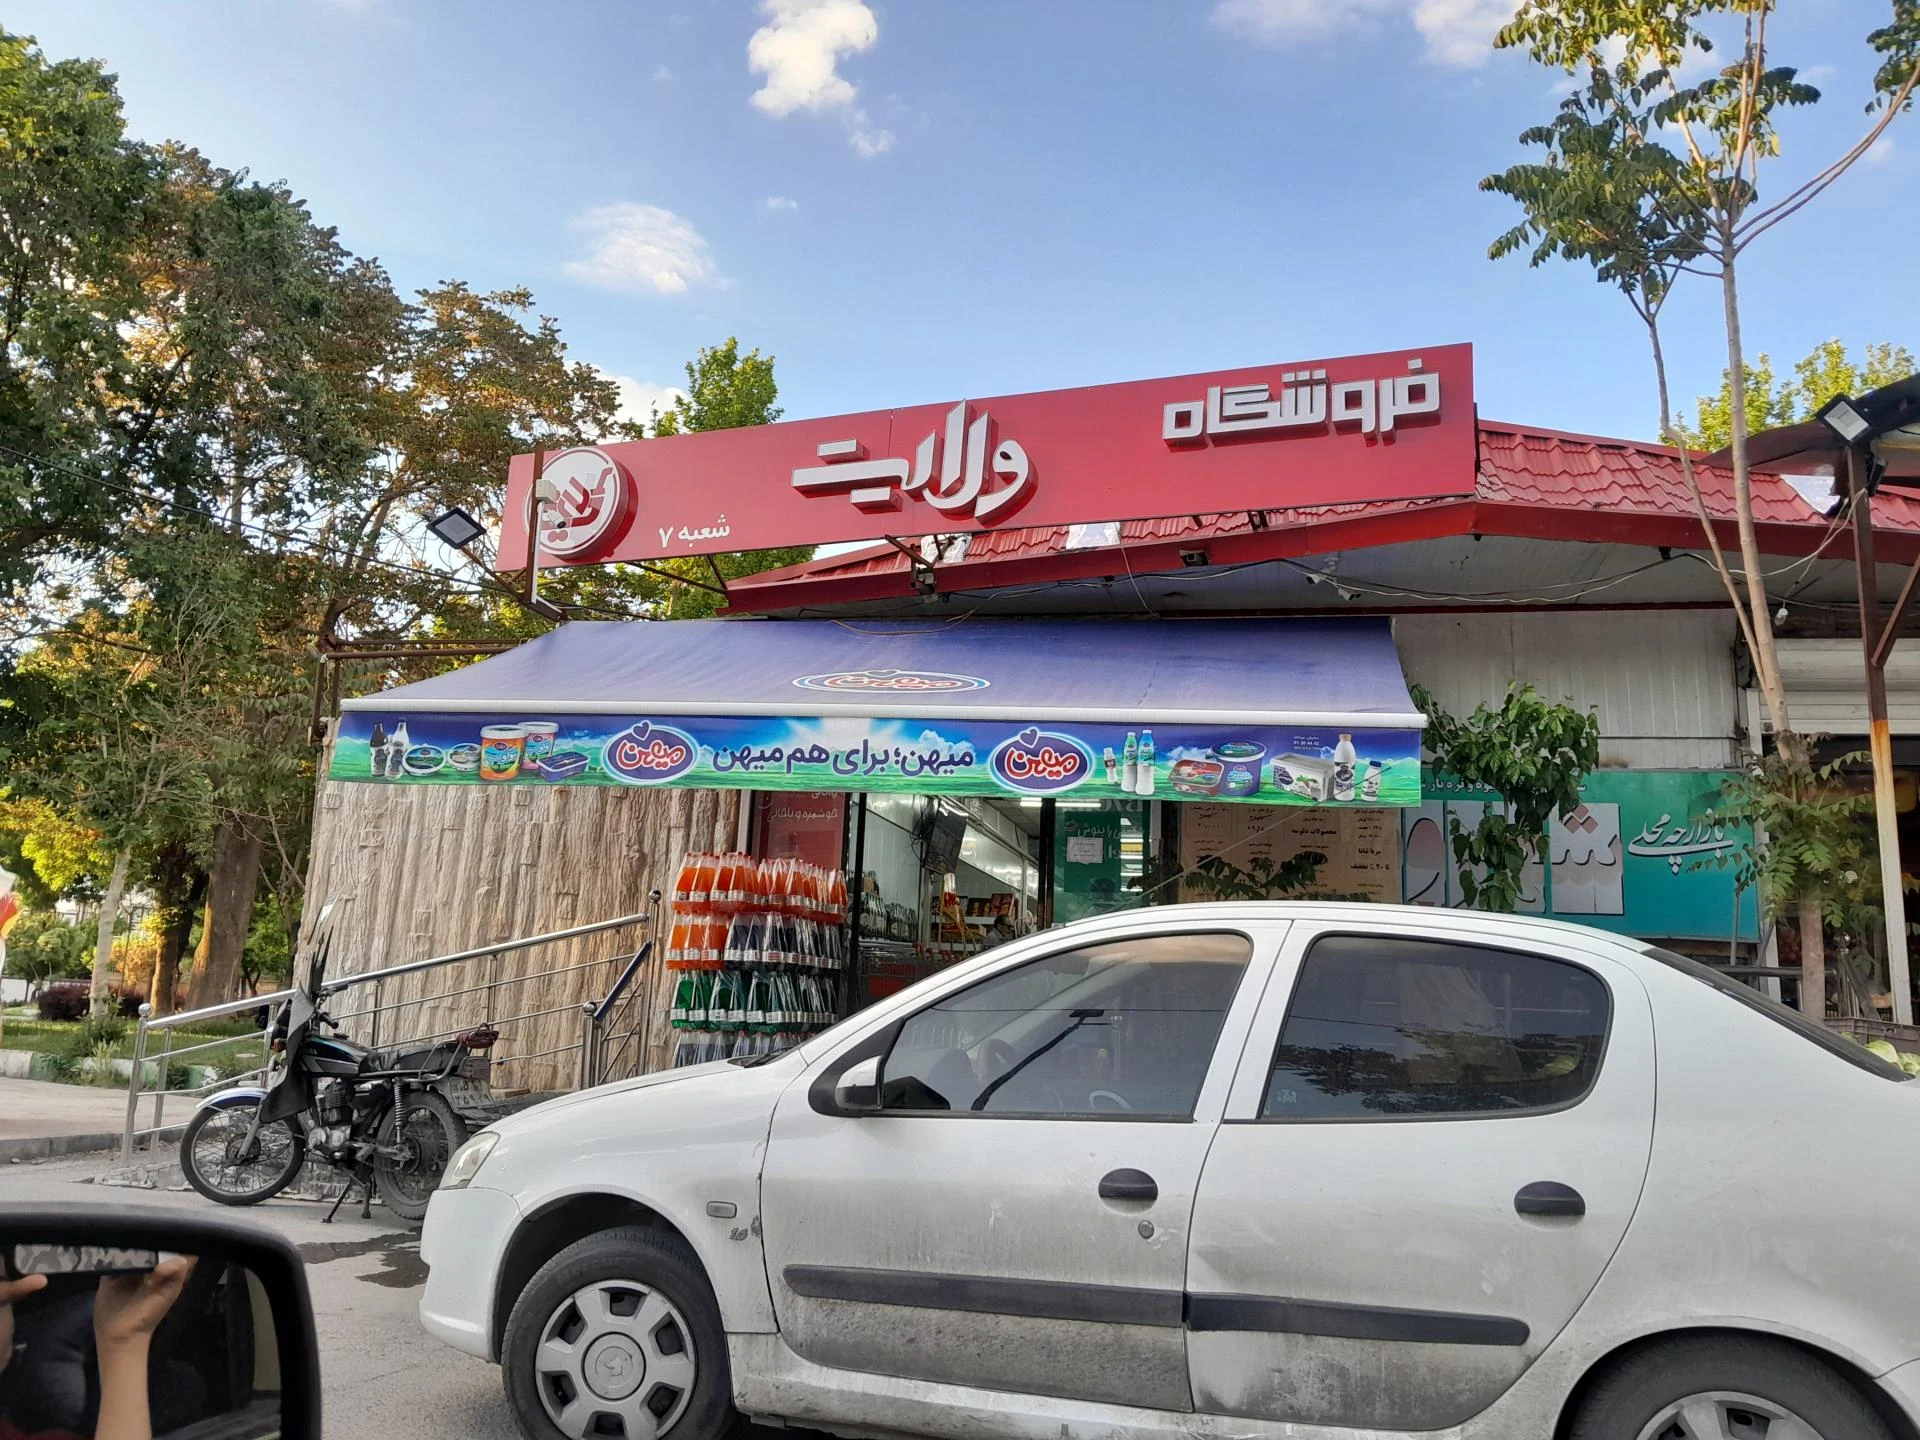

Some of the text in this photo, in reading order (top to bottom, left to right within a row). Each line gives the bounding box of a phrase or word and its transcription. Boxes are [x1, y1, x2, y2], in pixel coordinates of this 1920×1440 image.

[791, 358, 1441, 520] فروشگاه ولایت
[658, 514, 731, 548] شعبه ۷
[615, 737, 687, 771] میهن
[712, 743, 783, 773] میهن
[785, 743, 830, 775] هم
[833, 738, 890, 777] برای
[1005, 745, 1082, 780] میهن
[1430, 778, 1445, 792] بار
